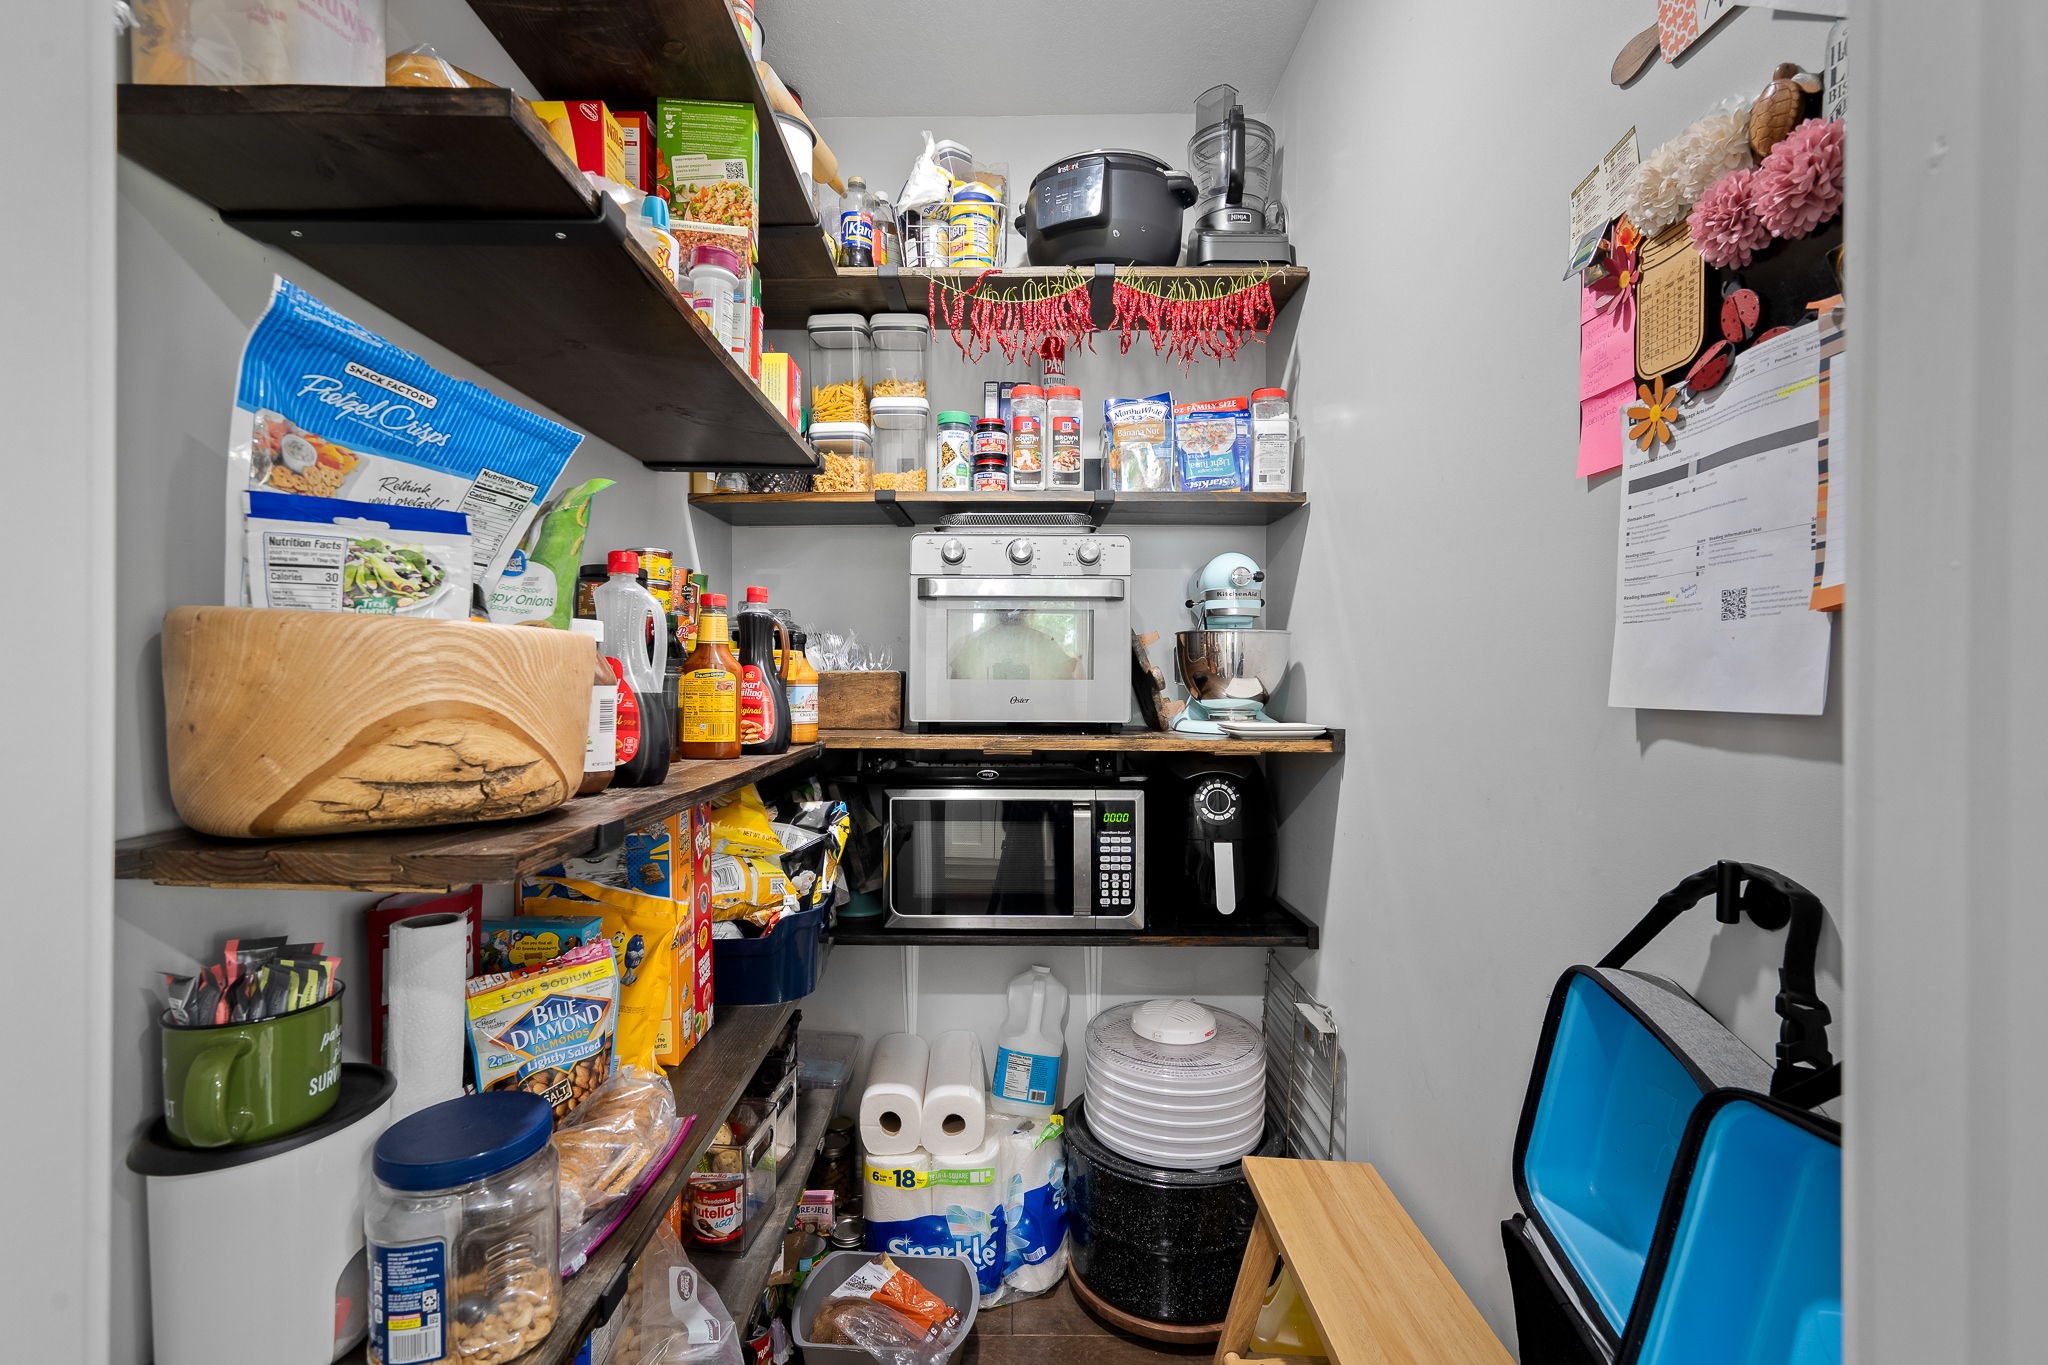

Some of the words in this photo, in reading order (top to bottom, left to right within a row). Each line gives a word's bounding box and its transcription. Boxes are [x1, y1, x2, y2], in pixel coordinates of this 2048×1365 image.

[1231, 213, 1247, 221] NINJA
[849, 221, 873, 236] Karo
[1045, 359, 1064, 375] PAM
[348, 364, 384, 385] SNACK
[385, 379, 434, 406] FACTORY
[297, 374, 390, 421] Pretzel
[379, 404, 452, 450] Crisps
[1187, 403, 1217, 412] FAMILY
[1218, 400, 1237, 409] SIZE
[1117, 428, 1145, 437] Banana
[1145, 427, 1160, 435] Nut
[379, 476, 433, 497] Rethink
[482, 469, 516, 486] Nutrition
[516, 481, 535, 493] Facts
[469, 490, 497, 503] Calories
[507, 500, 524, 511] 110
[269, 536, 311, 548] Nutrition
[314, 539, 342, 550] Facts
[270, 572, 303, 582] Calories
[325, 572, 339, 583] 30
[362, 598, 389, 608] Fresh
[515, 594, 553, 607] Onions
[1009, 695, 1030, 705] Oster
[501, 987, 536, 1004] LOW
[540, 969, 592, 990] SODIUM
[532, 998, 580, 1027] BLUE
[510, 1004, 602, 1051] DIAMOND
[534, 1028, 591, 1055] ALMONDS
[527, 1052, 566, 1072] Lightly
[568, 1038, 602, 1059] Salted
[872, 1171, 879, 1181] 6
[893, 1169, 916, 1188] 18
[693, 1206, 734, 1219] nutella
[714, 1214, 736, 1229] &GO!
[888, 1236, 996, 1266] Sparkle
